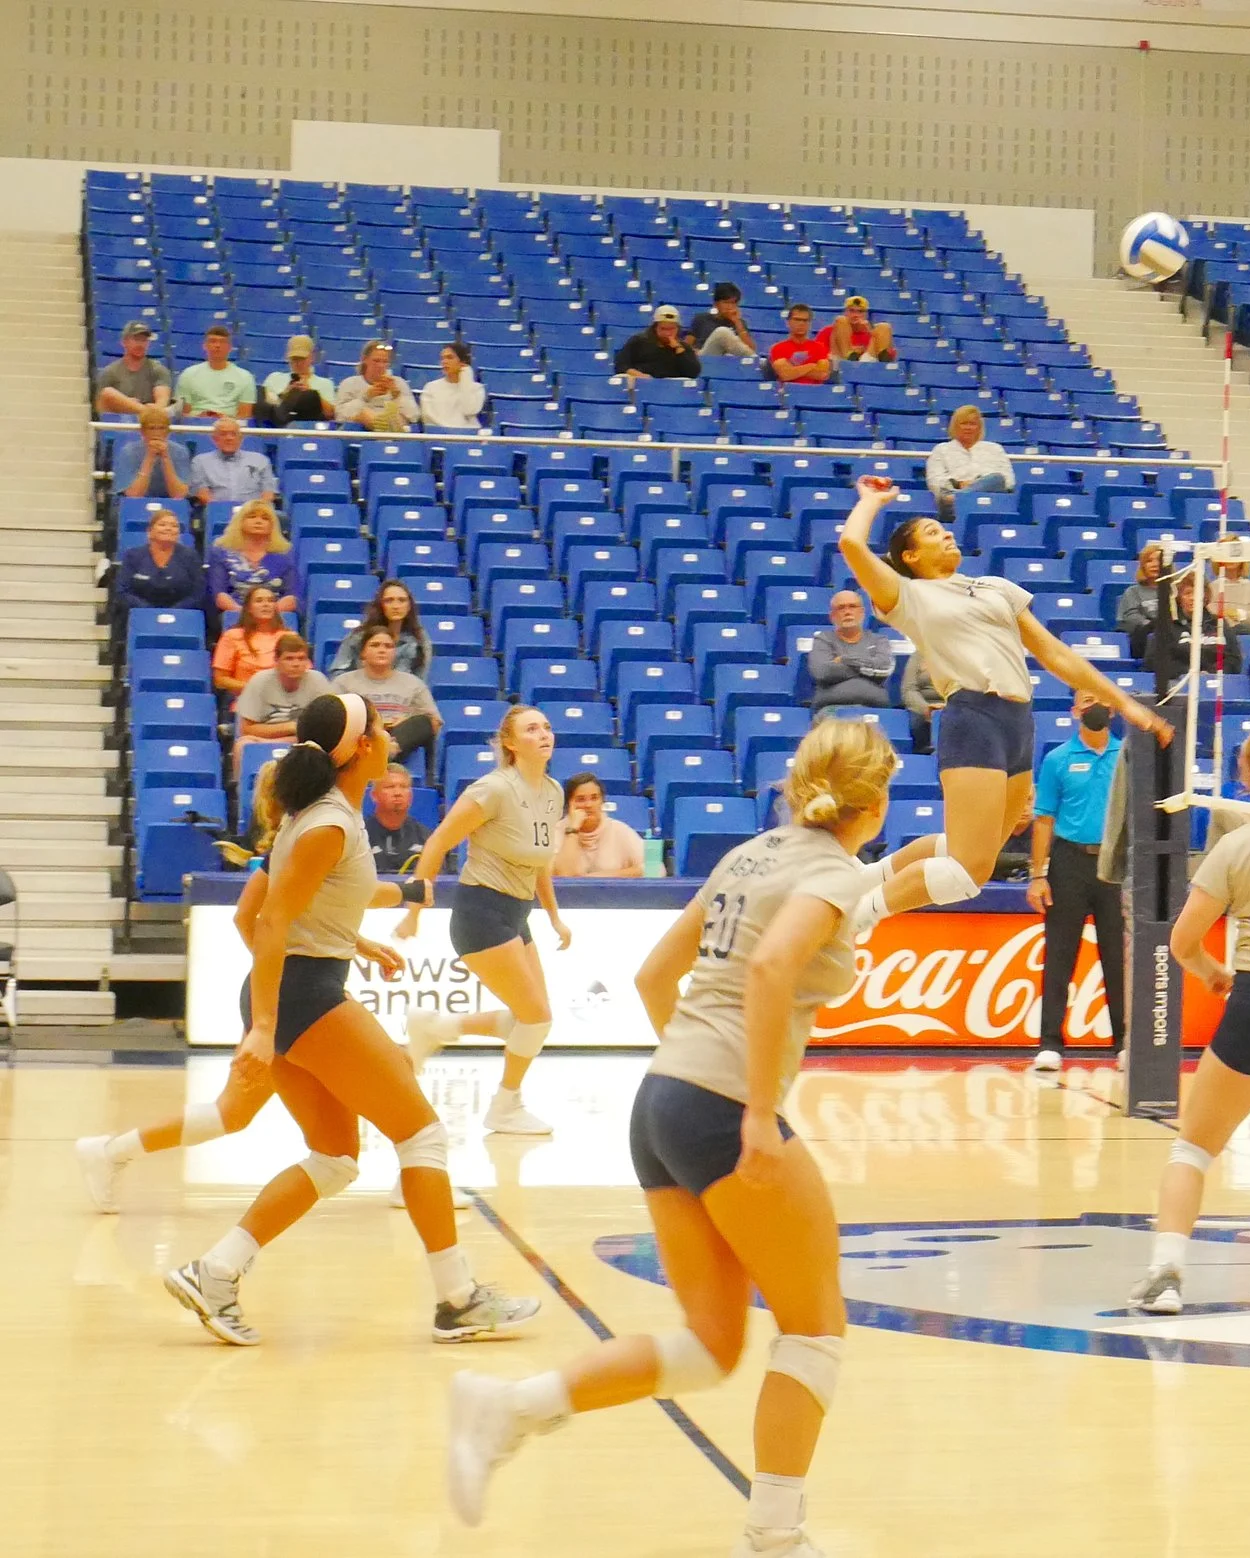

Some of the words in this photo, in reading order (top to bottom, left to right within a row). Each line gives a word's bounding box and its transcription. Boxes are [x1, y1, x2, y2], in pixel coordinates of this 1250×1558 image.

[533, 821, 550, 848] 13
[1153, 945, 1170, 990] sports
[1151, 991, 1169, 1047] imports
